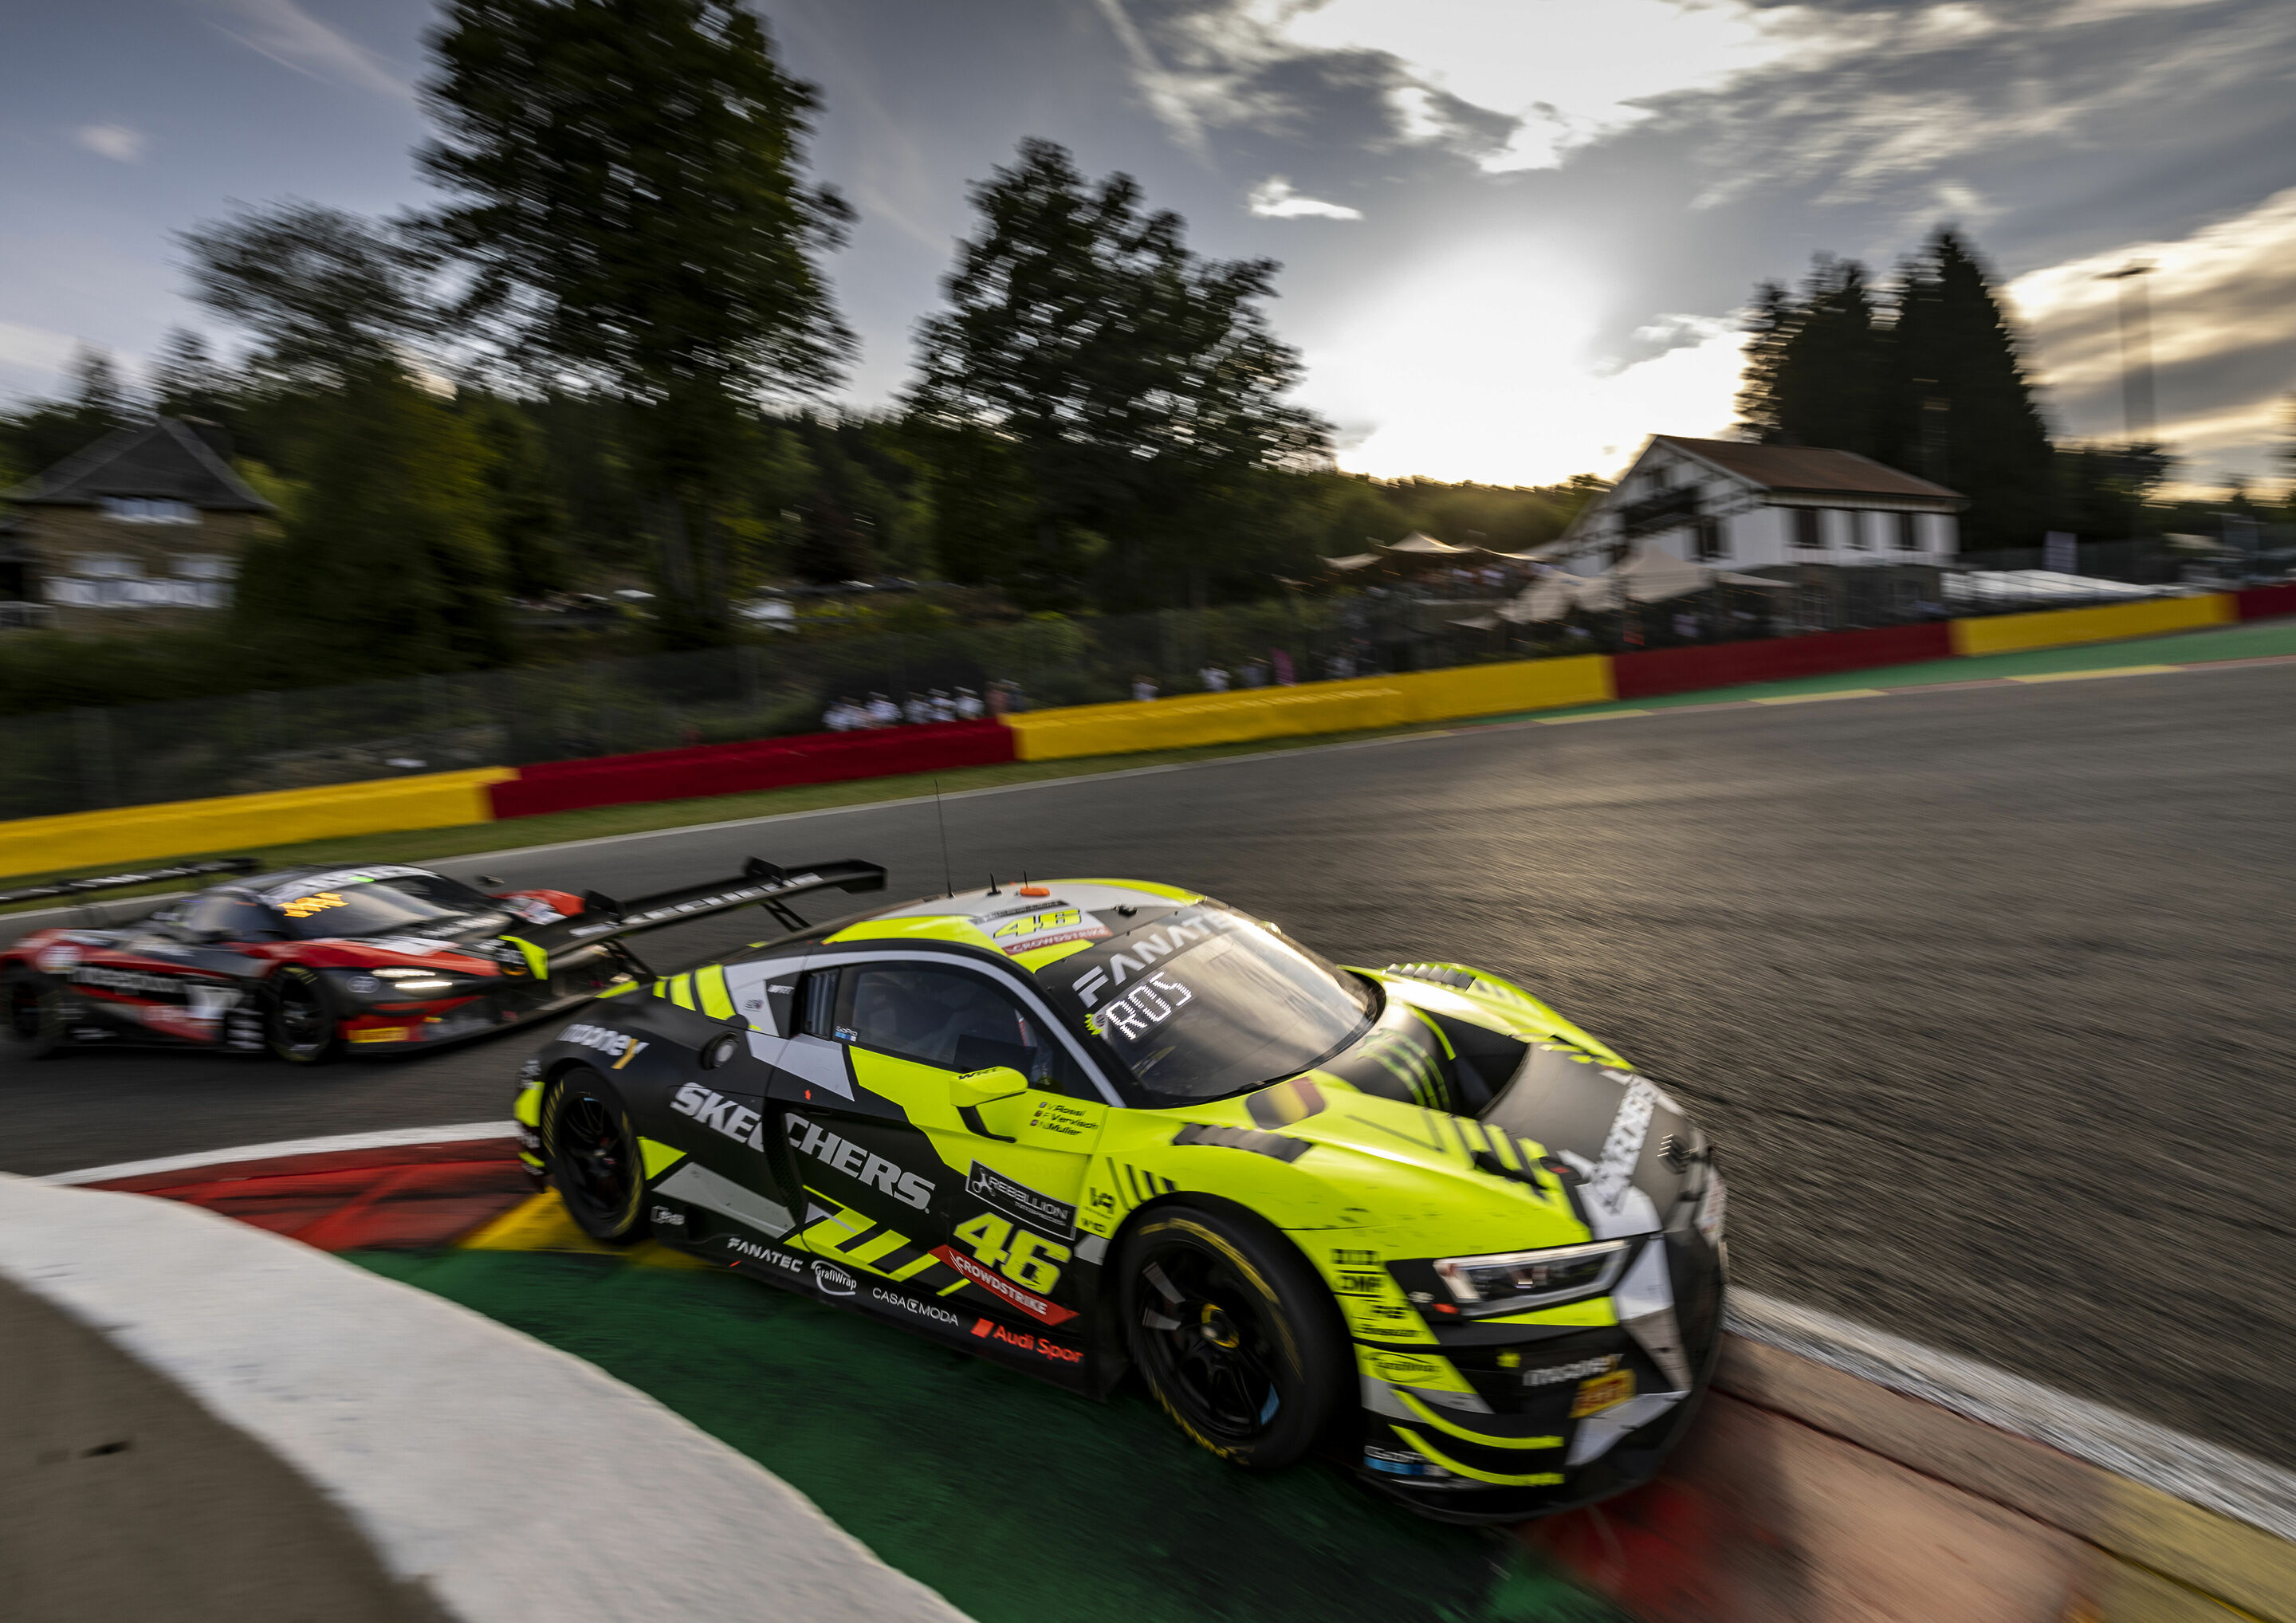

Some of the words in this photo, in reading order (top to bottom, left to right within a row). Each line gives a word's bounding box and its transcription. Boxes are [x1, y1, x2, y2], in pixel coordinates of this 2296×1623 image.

[993, 908, 1082, 939] 46
[1072, 910, 1234, 1008] FANATE
[835, 1025, 859, 1037] GoPro
[727, 1237, 803, 1273] FANATEC
[953, 1212, 1071, 1295] 46
[815, 1265, 857, 1291] GrafiWrap
[956, 1256, 1048, 1316] CROWDSTRIKE
[993, 1324, 1035, 1351] Audi
